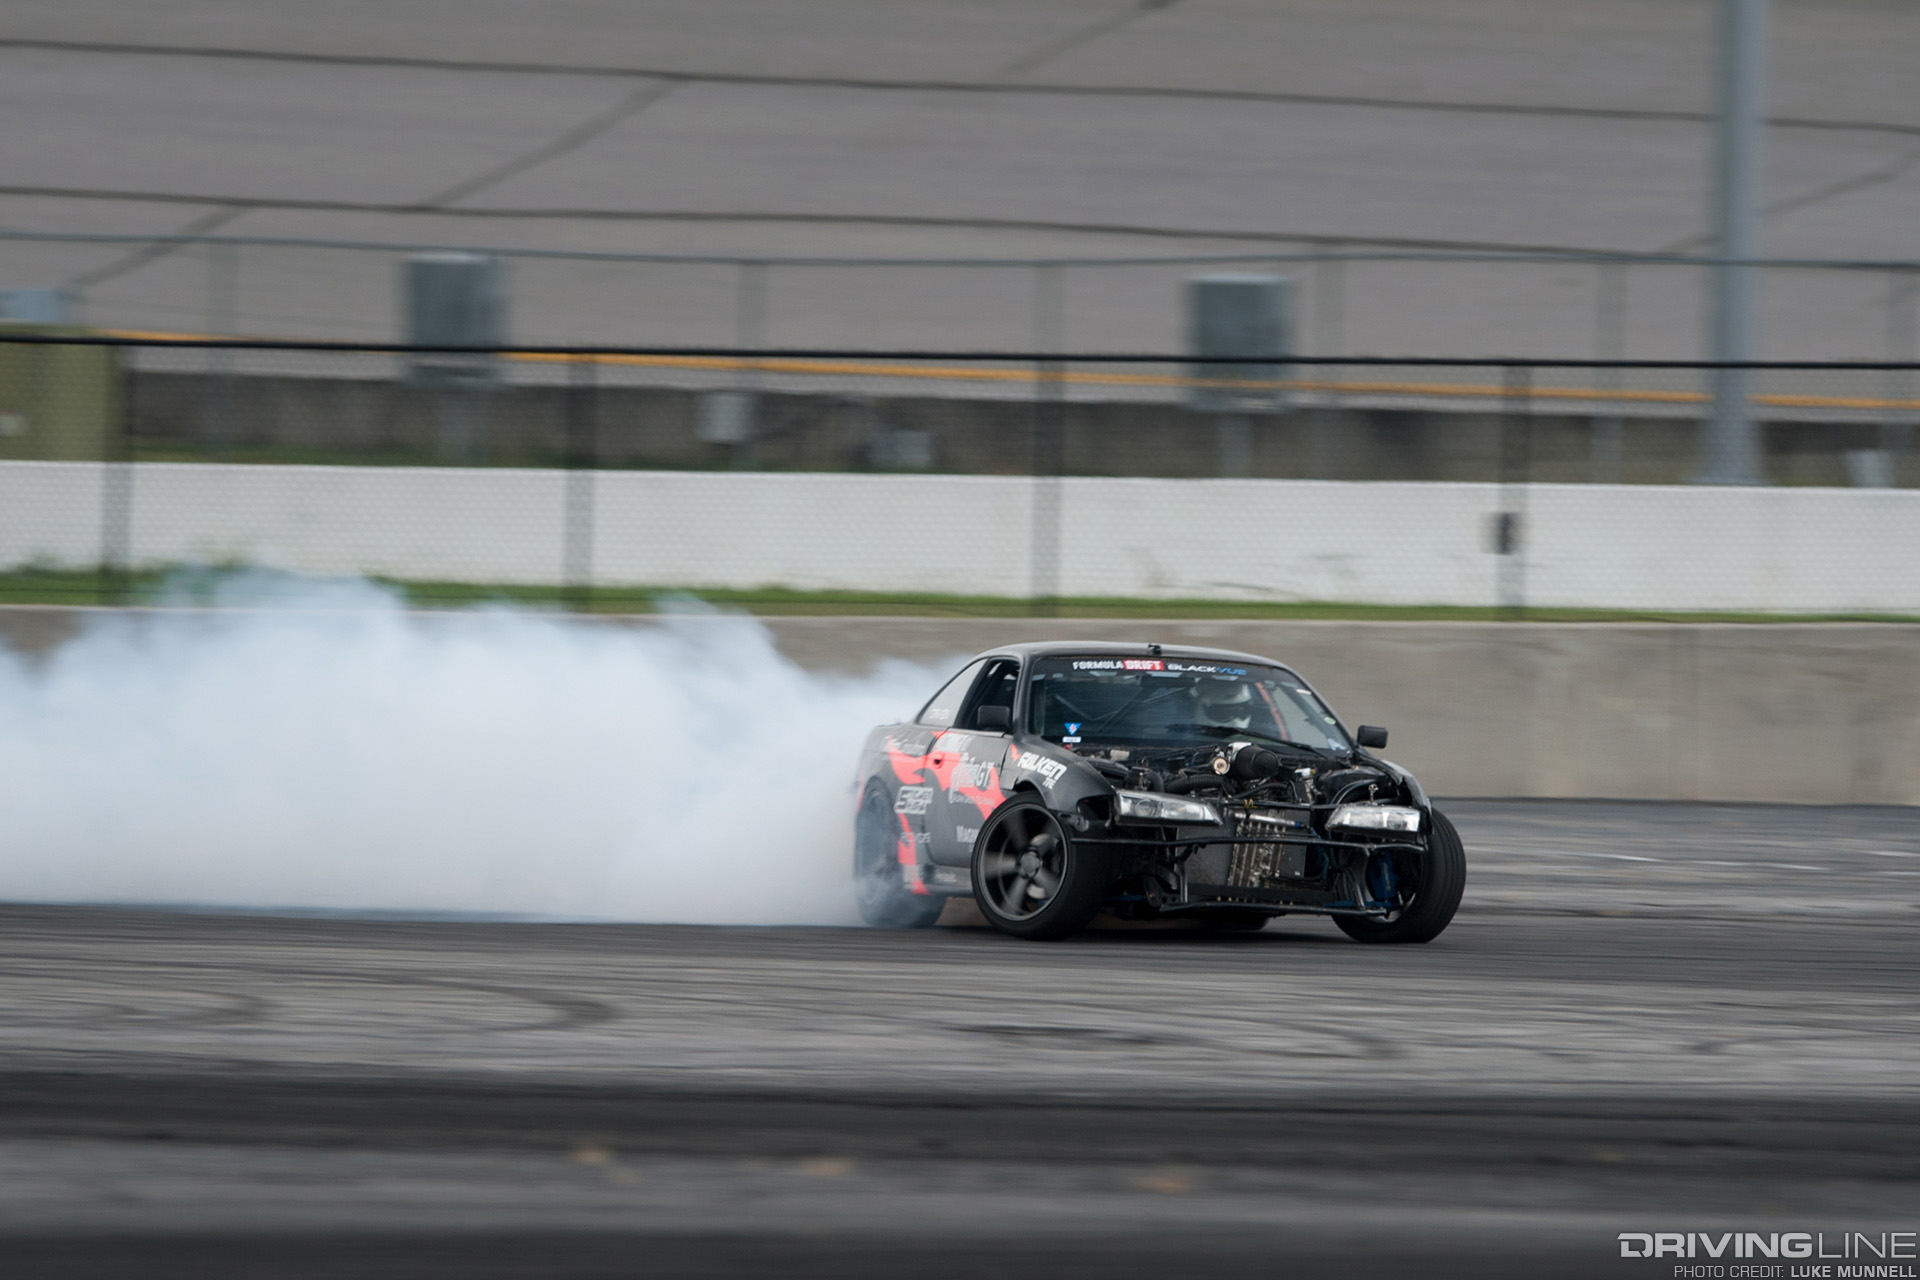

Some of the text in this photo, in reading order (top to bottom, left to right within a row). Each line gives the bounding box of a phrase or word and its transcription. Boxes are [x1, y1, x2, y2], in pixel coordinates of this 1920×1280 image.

[1072, 659, 1162, 670] FORMULA DRIFT
[1017, 751, 1067, 780] FALKEN
